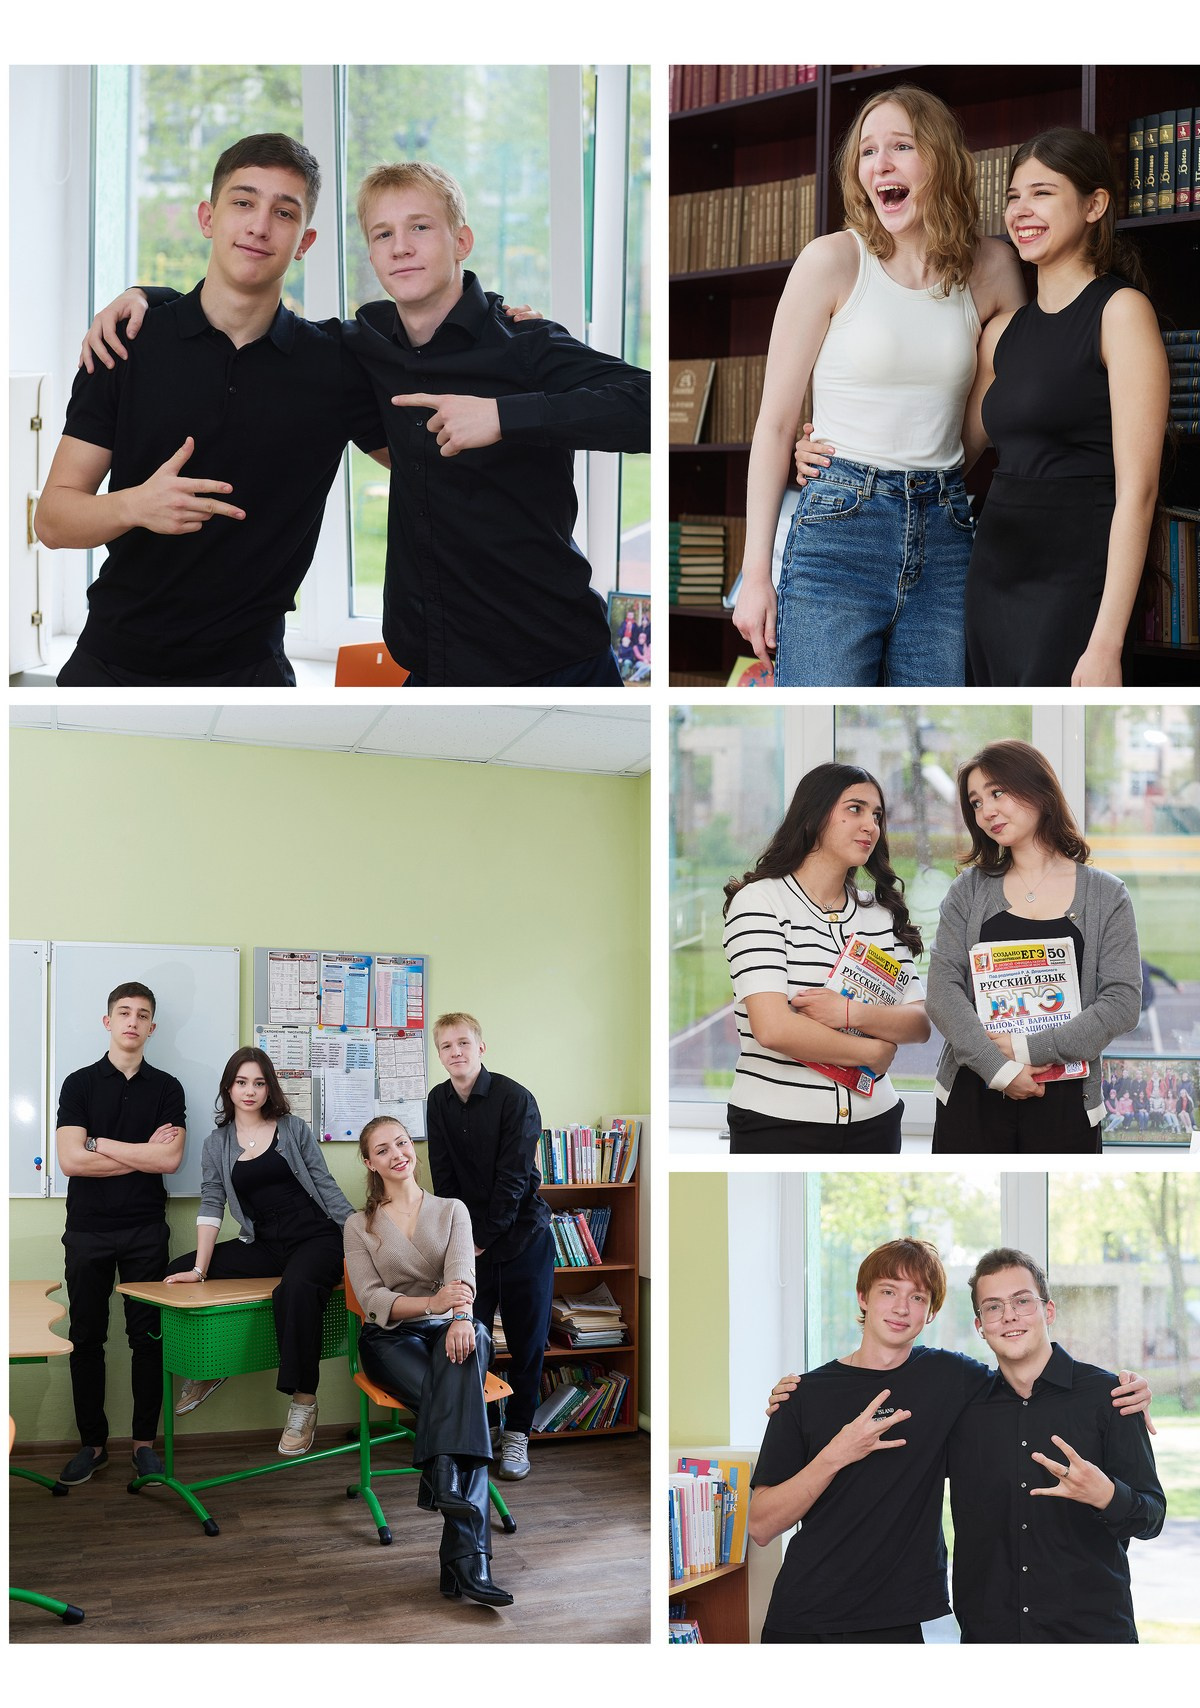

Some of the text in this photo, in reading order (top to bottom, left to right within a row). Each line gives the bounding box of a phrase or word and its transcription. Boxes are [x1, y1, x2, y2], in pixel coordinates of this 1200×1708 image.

[1021, 949, 1044, 959] ЕГЭ
[1047, 948, 1066, 959] 50
[868, 949, 885, 963] СОЗДАНО
[883, 959, 899, 977] ЕГЭ
[841, 966, 881, 995] РУССКИЙ
[879, 989, 897, 1006] ЯЗЫК
[897, 970, 910, 986] 50
[980, 973, 1066, 991] РУССКИЙ ЯЗЫК
[986, 984, 1065, 1020] ЕГЭ
[1028, 1013, 1071, 1025] ВАРИАНТЫ
